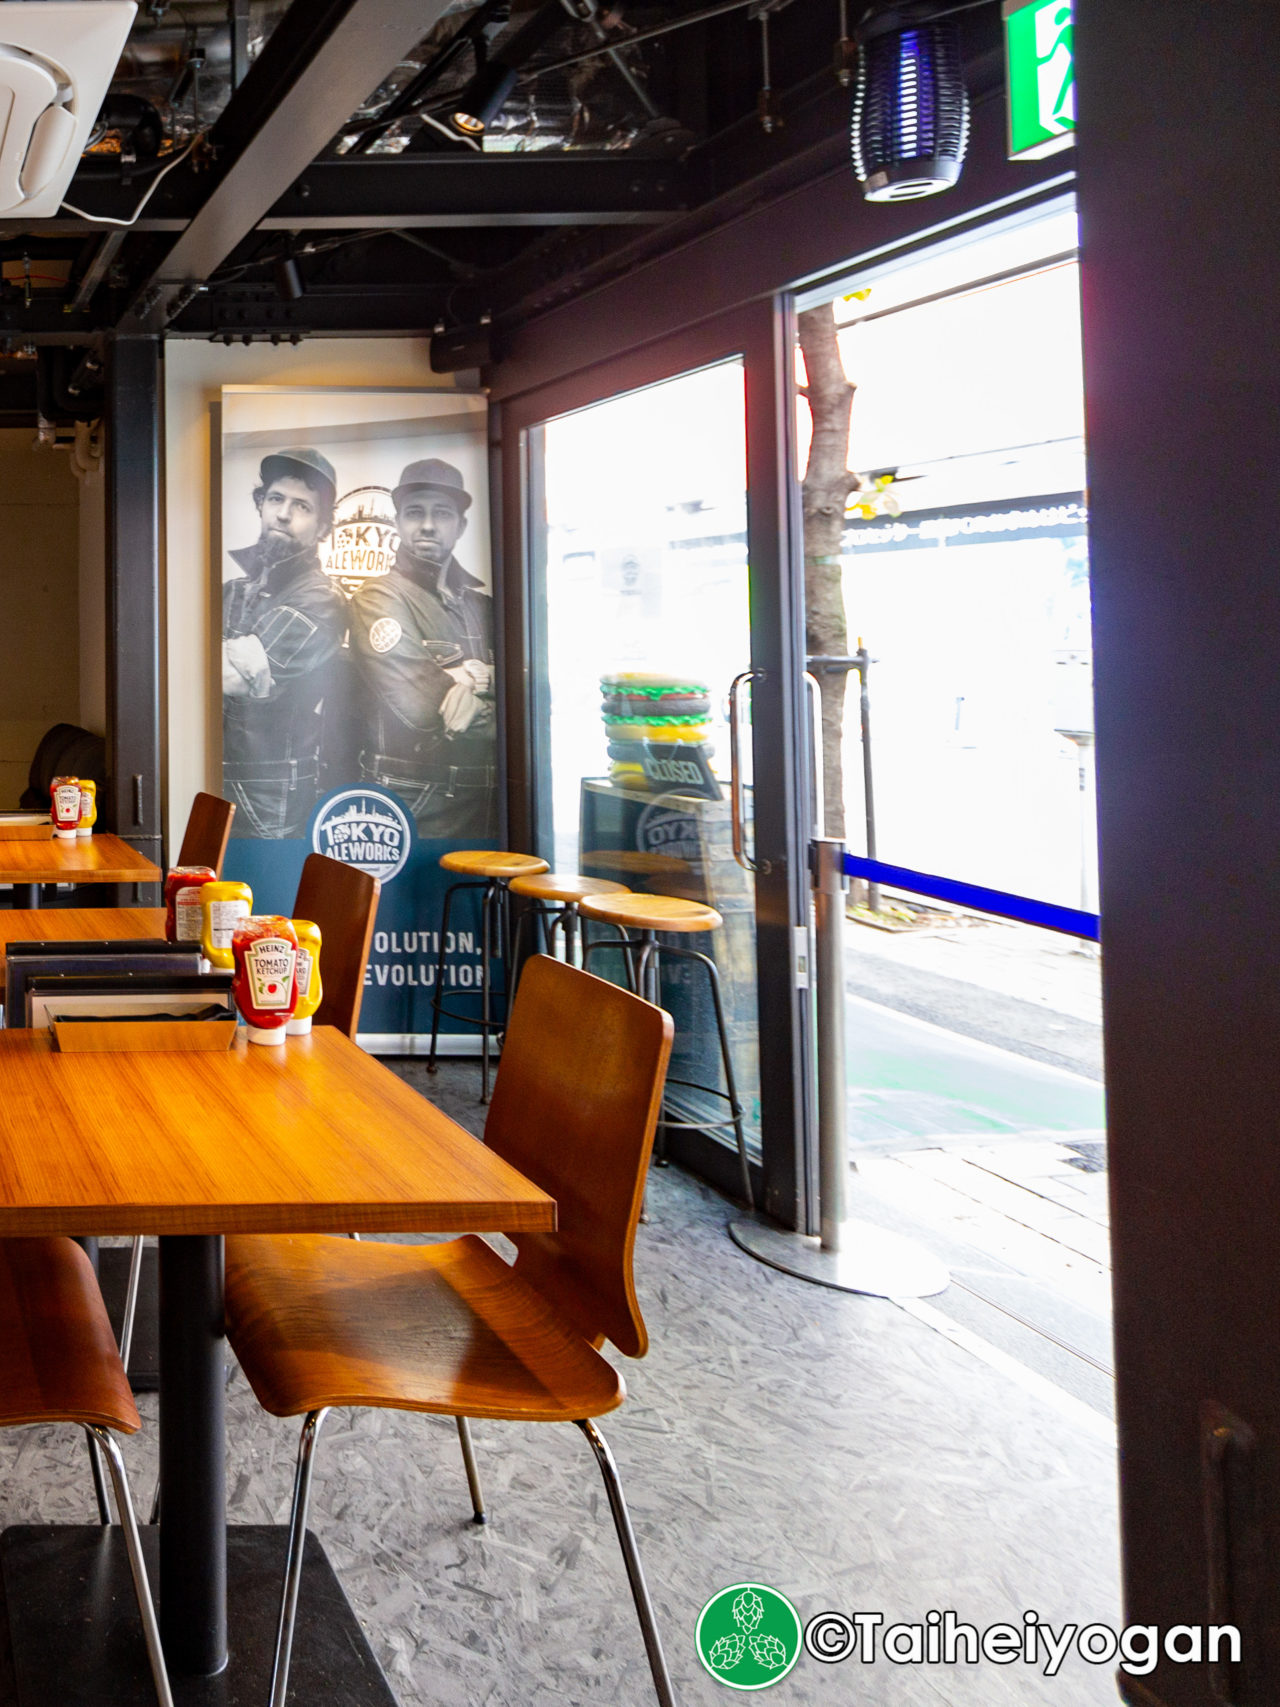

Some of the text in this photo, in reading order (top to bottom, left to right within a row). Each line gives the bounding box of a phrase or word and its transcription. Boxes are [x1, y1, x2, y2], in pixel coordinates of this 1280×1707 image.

[645, 759, 704, 785] CLOSED
[321, 821, 401, 847] TOKYO
[326, 842, 400, 861] ALEWORKS
[259, 944, 285, 953] HEINZ
[254, 958, 289, 967] TOMATO
[256, 967, 287, 975] KETCHUP
